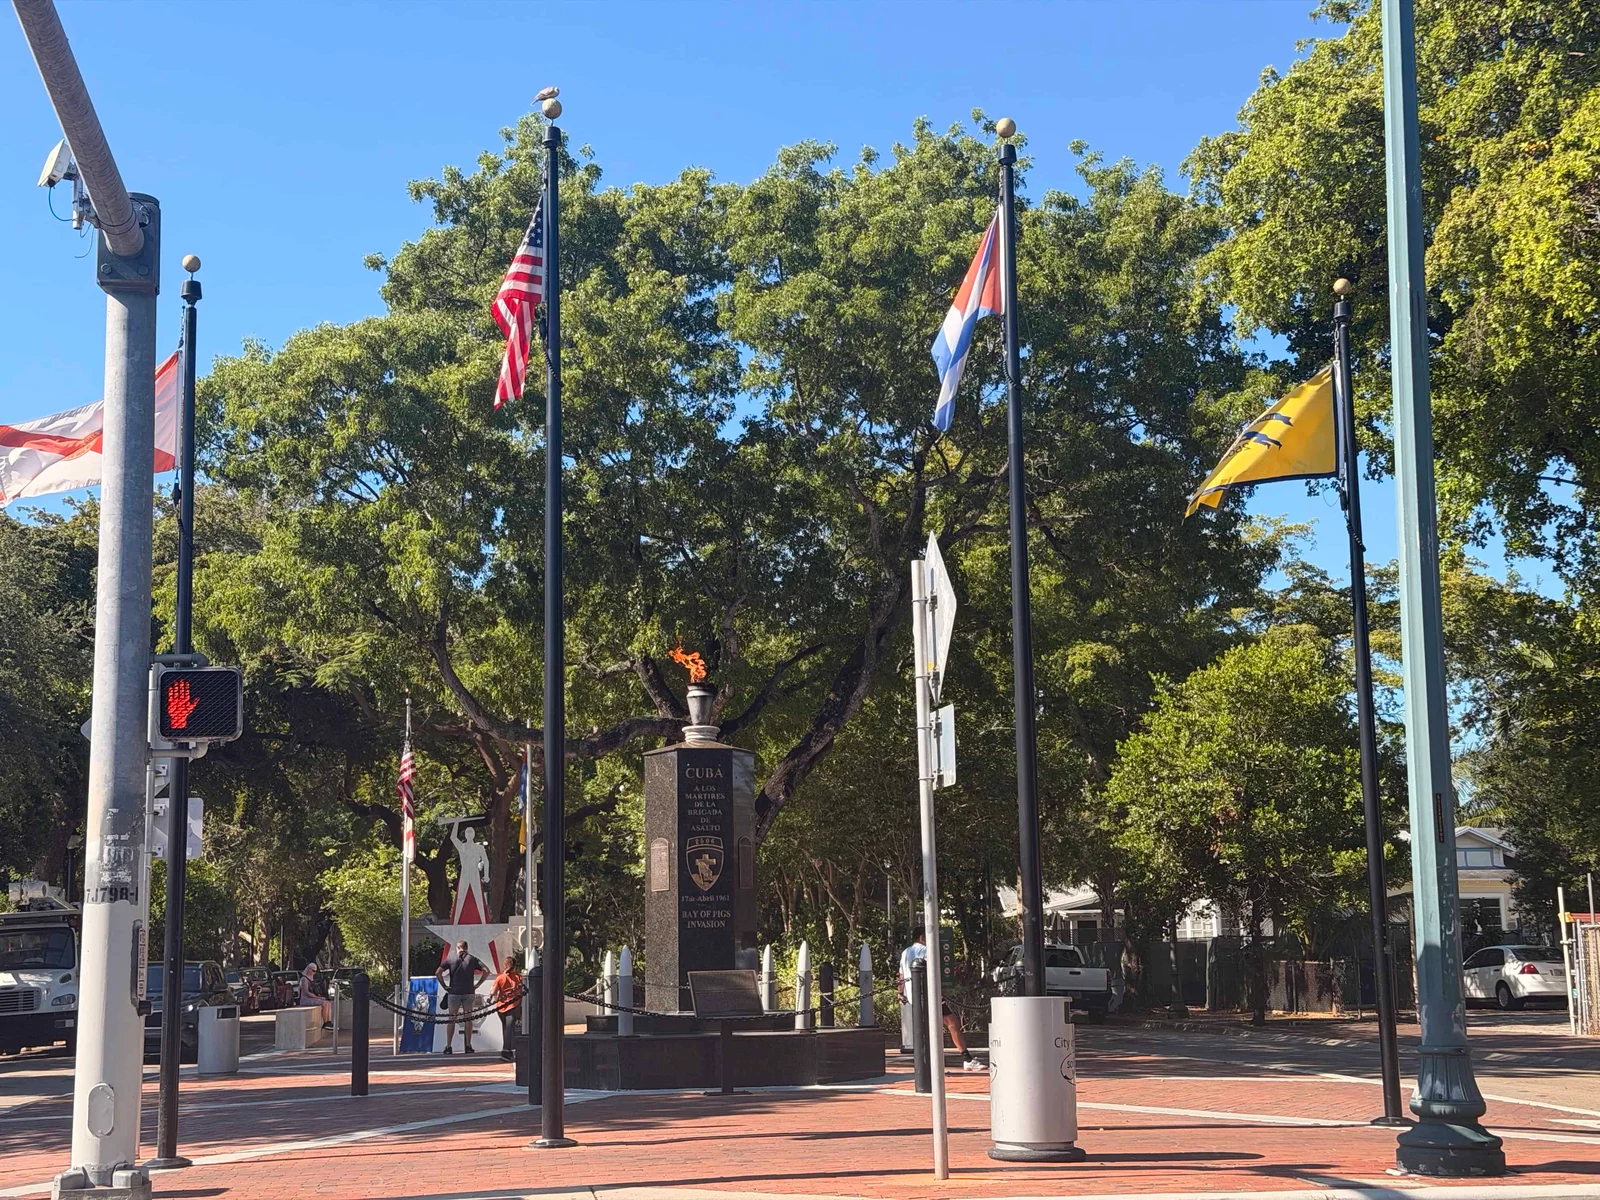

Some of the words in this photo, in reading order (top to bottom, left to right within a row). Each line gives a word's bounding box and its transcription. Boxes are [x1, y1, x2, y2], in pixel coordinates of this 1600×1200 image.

[685, 768, 723, 778] CUBA
[691, 824, 721, 832] ASALTO
[682, 910, 699, 919] BAY
[700, 910, 711, 918] OF
[712, 910, 731, 918] PIGS
[687, 920, 726, 929] INVASION
[1054, 1037, 1070, 1051] City
